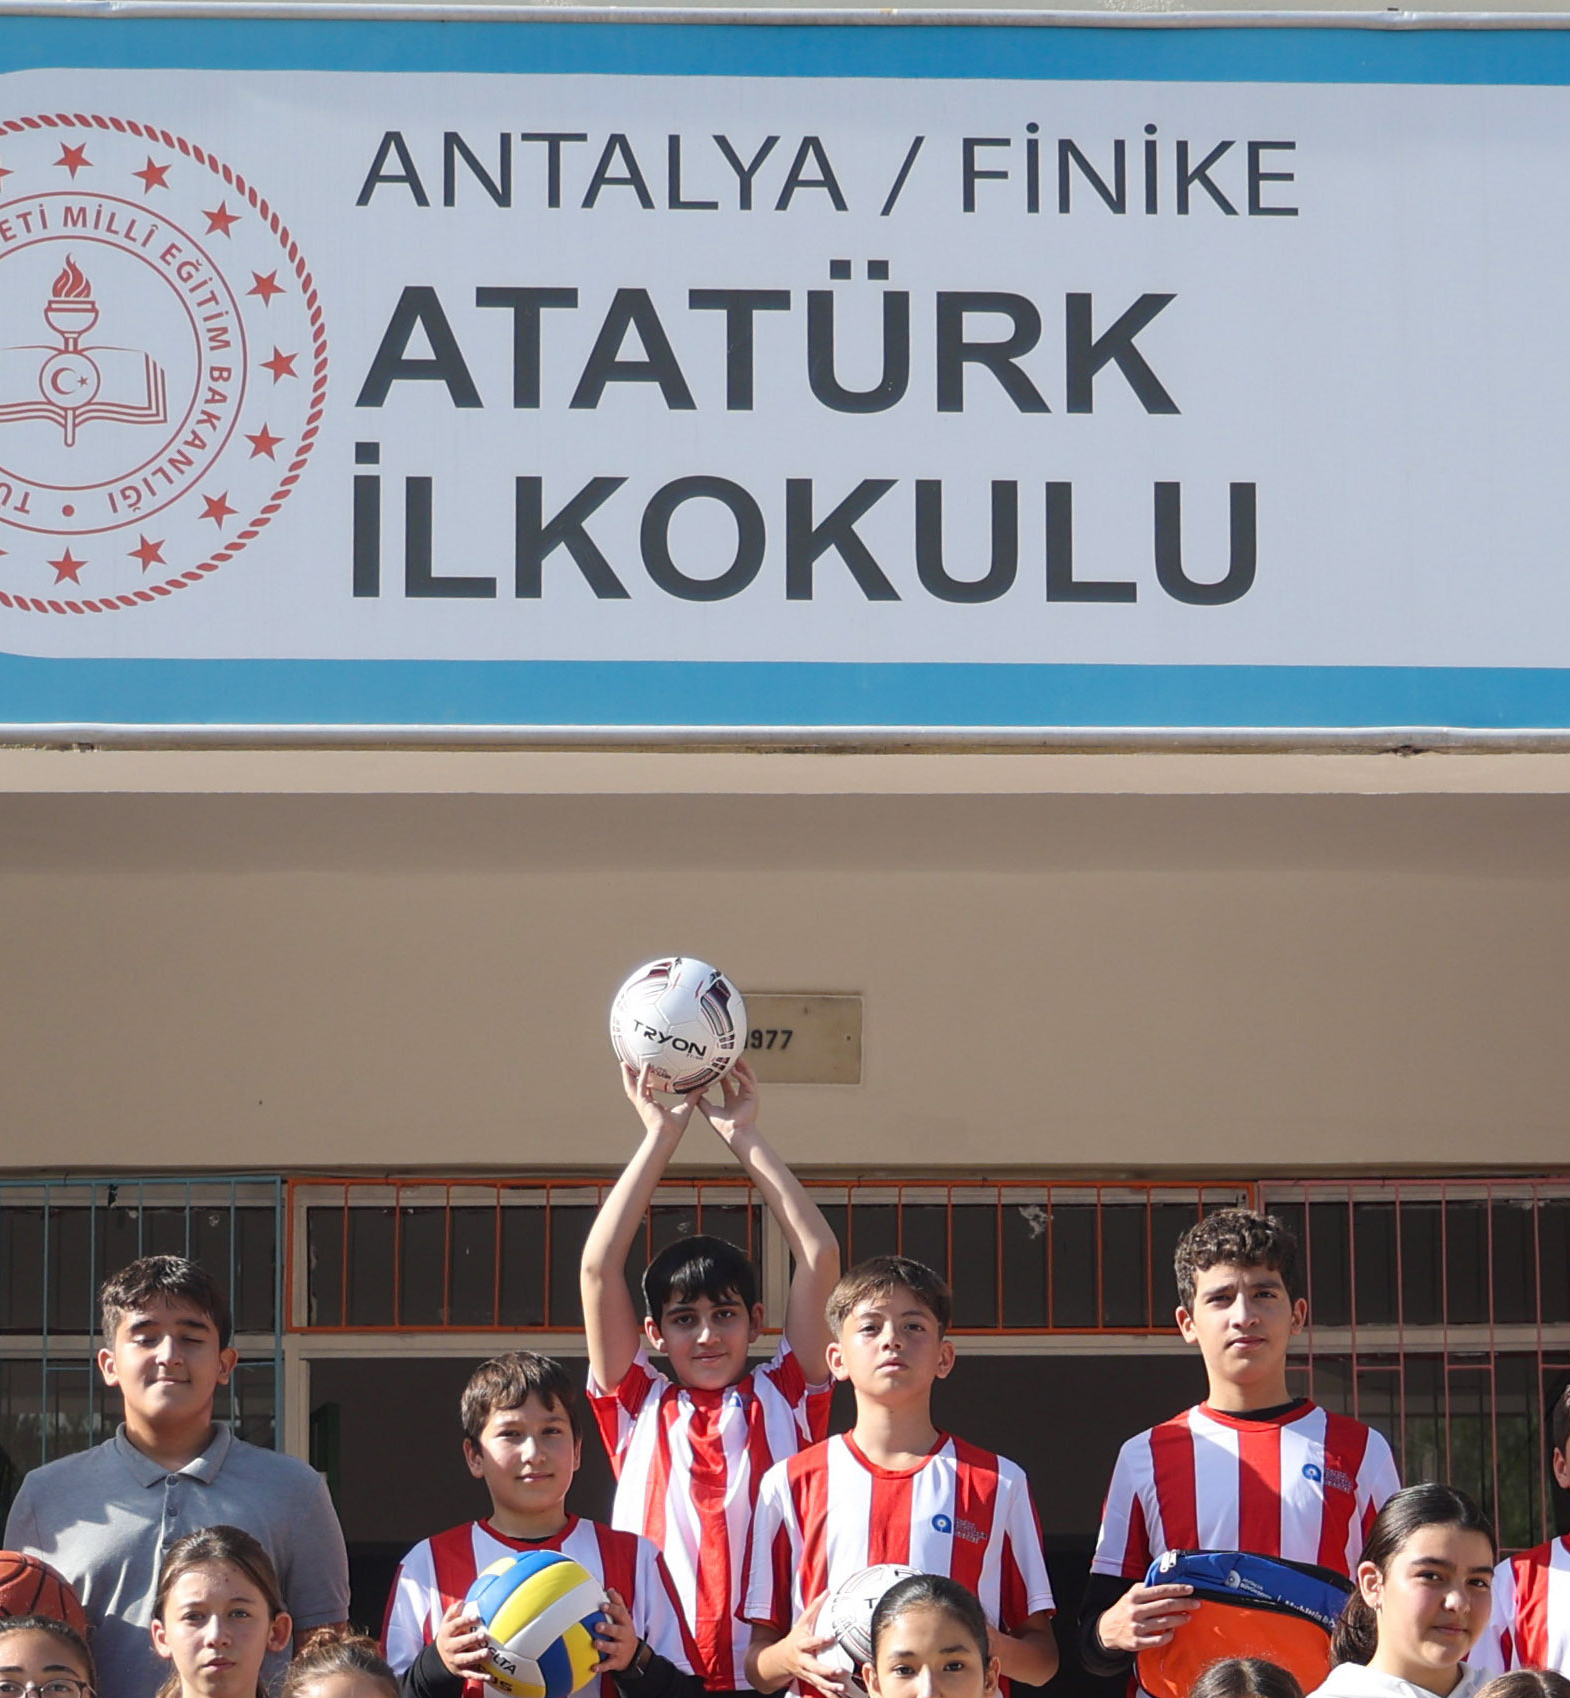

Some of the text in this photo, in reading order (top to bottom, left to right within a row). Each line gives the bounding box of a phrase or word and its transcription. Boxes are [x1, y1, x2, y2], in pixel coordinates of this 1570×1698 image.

[355, 121, 1299, 217] ANTALYA / FİNİKE
[62, 202, 159, 248] MİLLÎ
[159, 241, 232, 352] EĞİTİM
[355, 259, 1181, 415] ATATÜRK
[107, 365, 232, 514] BAKANLIĞI
[352, 441, 1257, 606] İLKOKULU
[633, 1018, 708, 1057] TRYON
